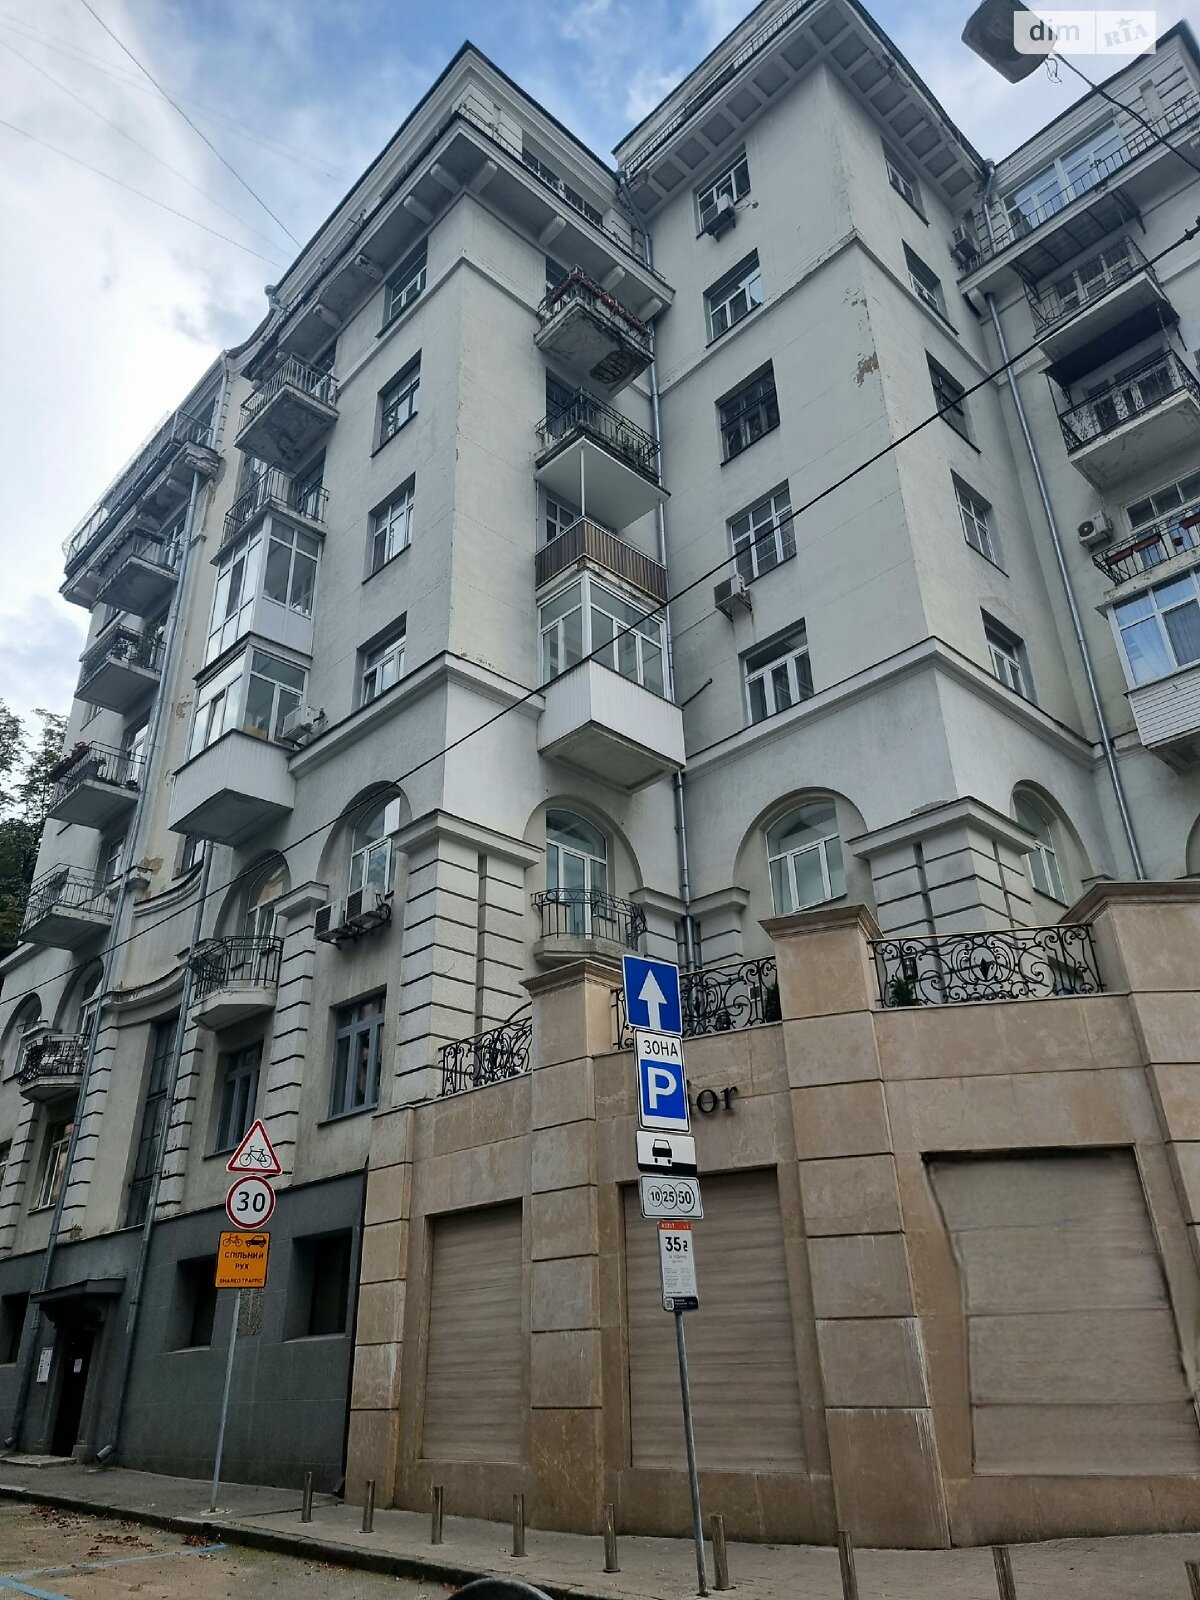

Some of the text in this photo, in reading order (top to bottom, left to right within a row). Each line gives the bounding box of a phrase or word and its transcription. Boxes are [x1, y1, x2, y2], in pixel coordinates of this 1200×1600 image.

[643, 1039, 679, 1058] ЗОНА
[647, 1066, 677, 1110] P
[236, 1191, 266, 1213] 30
[650, 1190, 692, 1205] 10 25 50
[224, 1251, 264, 1260] СПІЛЬНИЙ
[234, 1262, 250, 1270] РУХ
